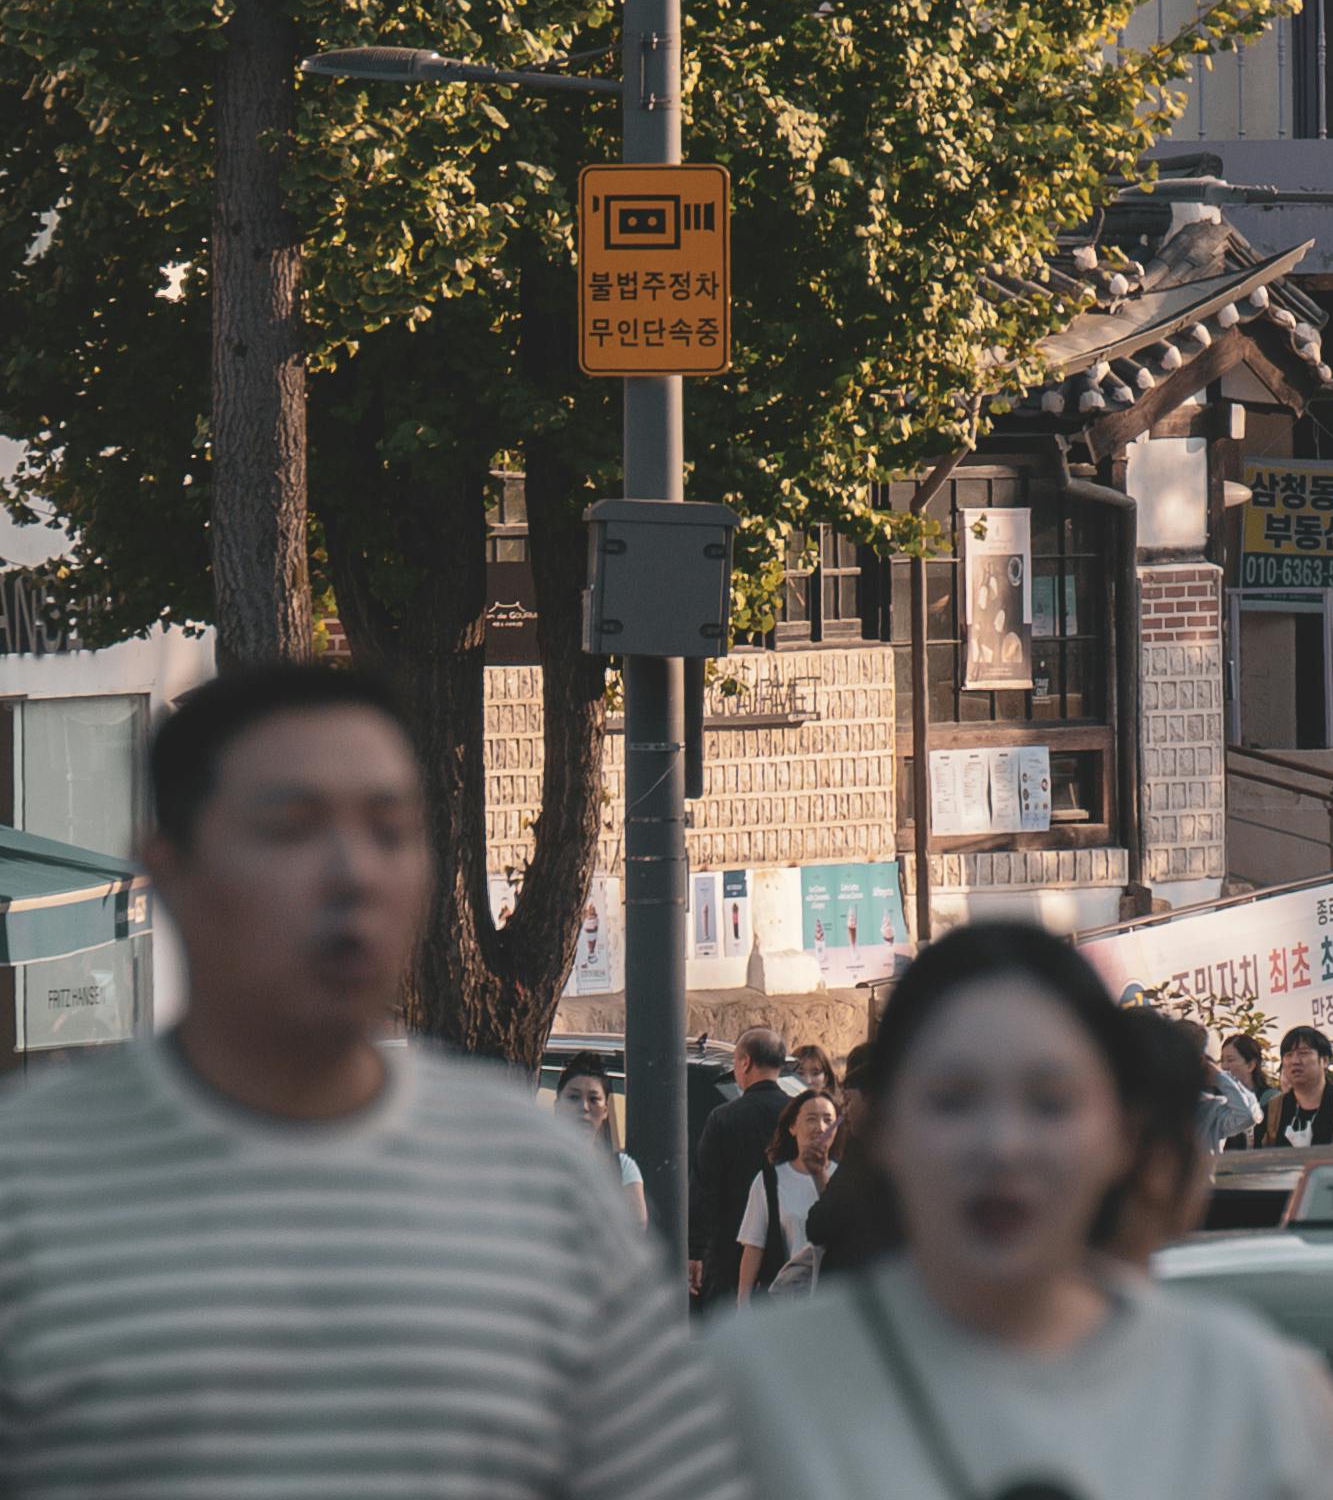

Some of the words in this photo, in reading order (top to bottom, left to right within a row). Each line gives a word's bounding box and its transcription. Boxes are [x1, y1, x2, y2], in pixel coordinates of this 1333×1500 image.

[588, 271, 720, 301] 불법주정차
[588, 317, 719, 347] 무인단속중
[1269, 941, 1312, 994] 최초
[48, 988, 71, 1009] FRITZ
